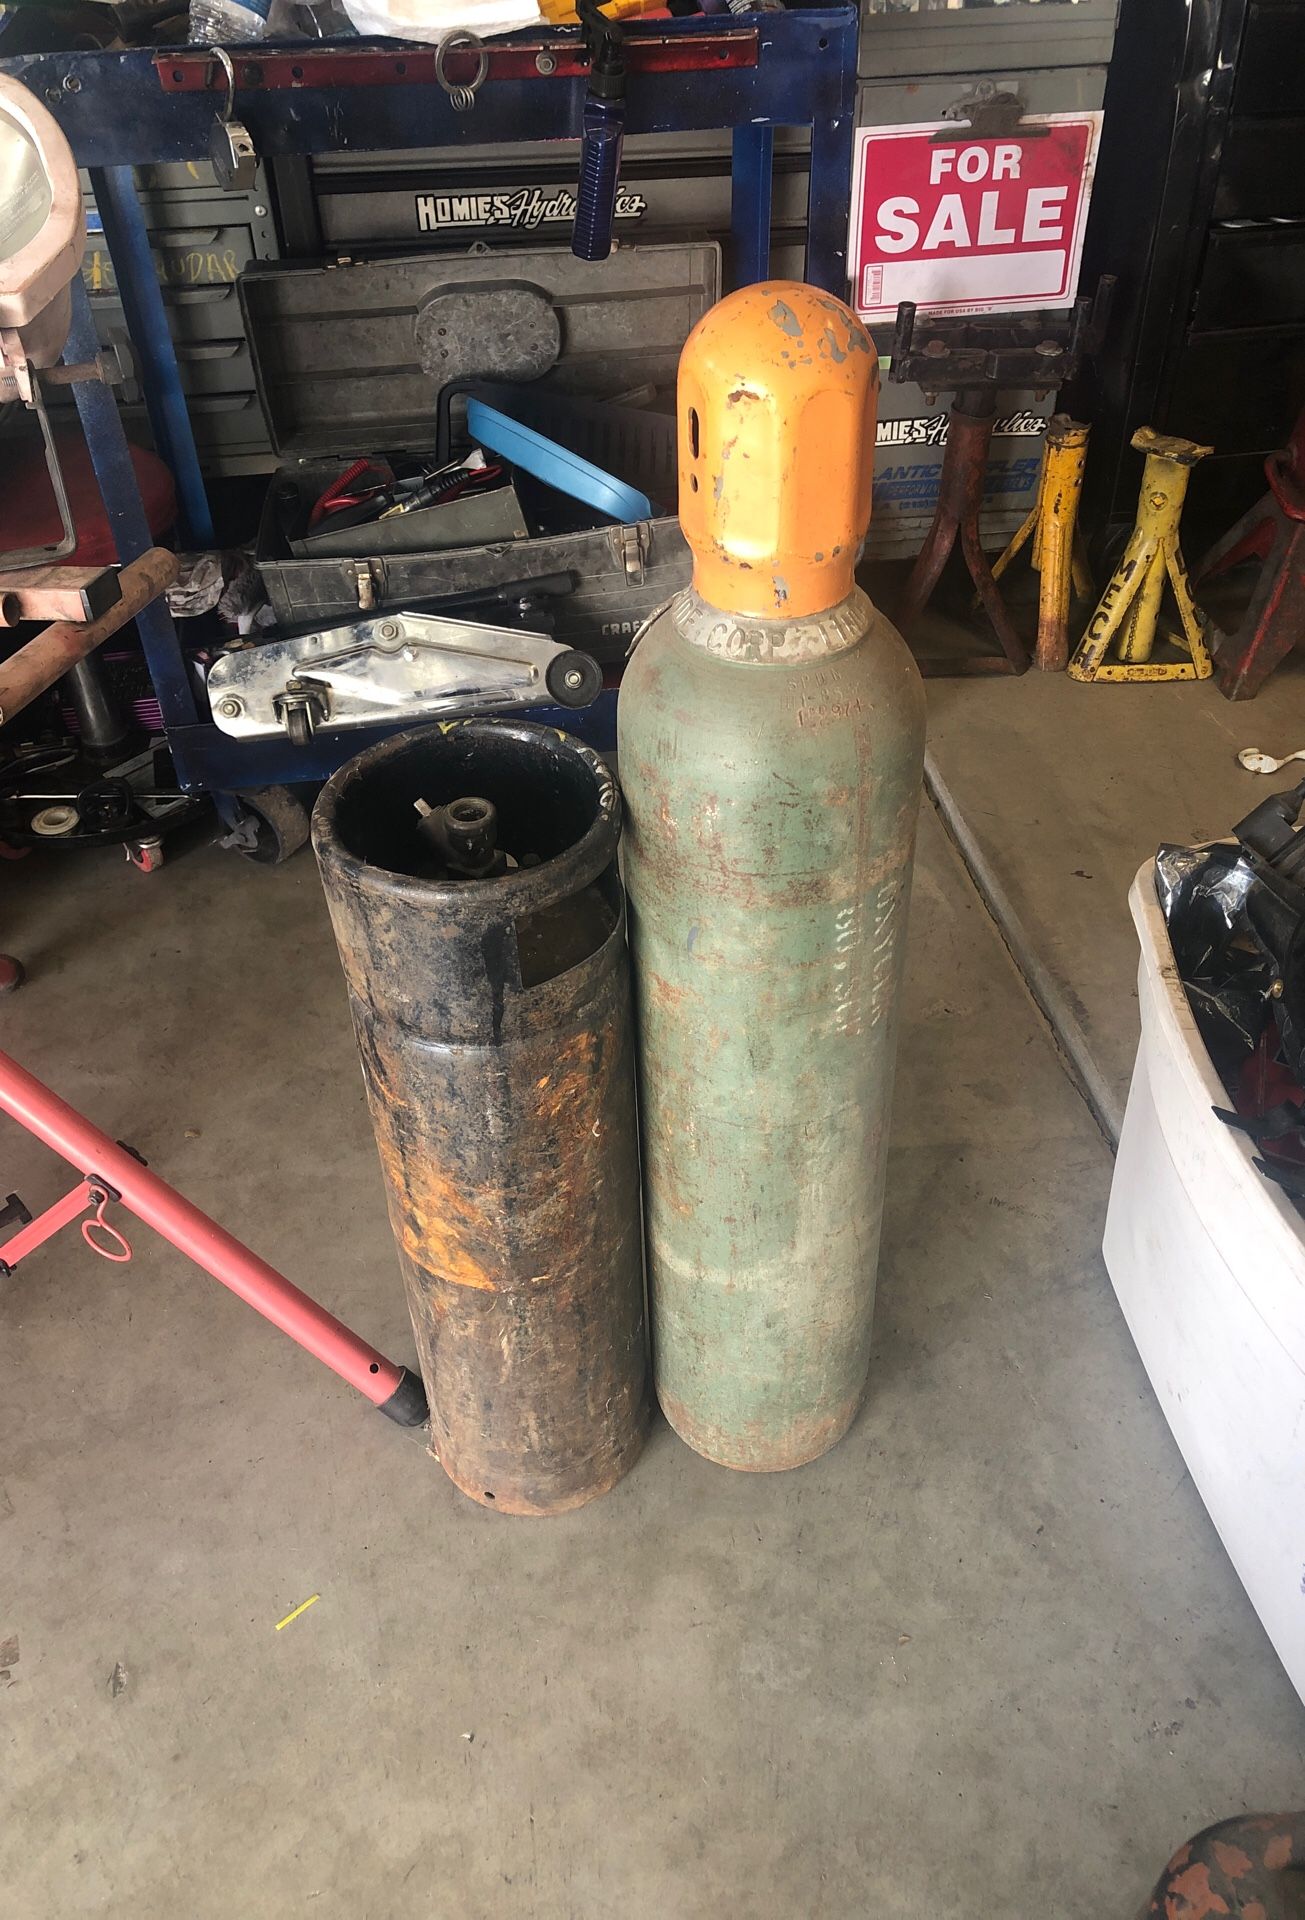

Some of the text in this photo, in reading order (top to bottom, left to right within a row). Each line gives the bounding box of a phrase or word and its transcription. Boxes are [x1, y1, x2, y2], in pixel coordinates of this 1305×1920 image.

[930, 145, 1023, 185] FOR
[874, 186, 1069, 254] SALE
[875, 419, 928, 445] MIES
[874, 464, 942, 481] ANTIC
